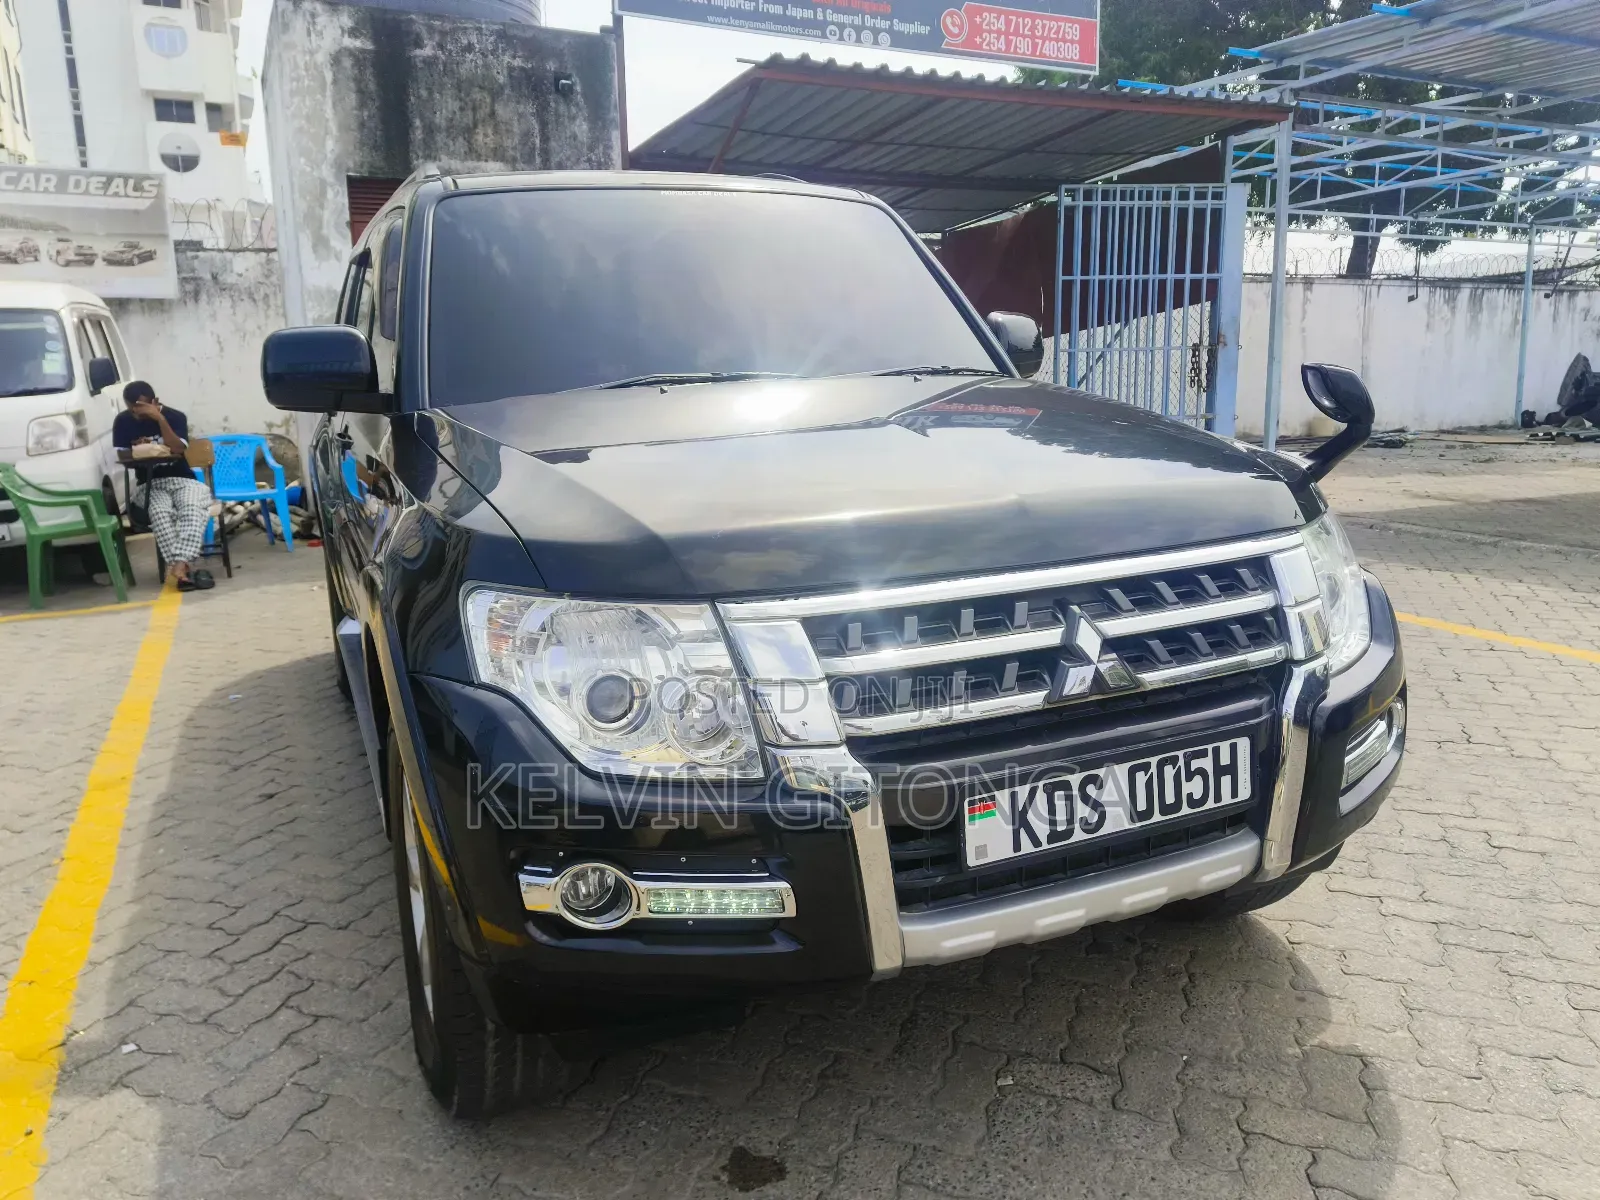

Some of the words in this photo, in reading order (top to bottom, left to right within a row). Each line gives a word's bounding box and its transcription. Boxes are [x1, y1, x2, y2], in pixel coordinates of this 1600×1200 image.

[706, 14, 822, 38] www.kenyamalikmotors.com
[758, 1, 784, 15] From
[785, 4, 814, 20] Japan
[816, 7, 825, 21] &
[826, 8, 862, 26] General
[864, 14, 892, 30] Order
[893, 18, 931, 36] Supplier
[974, 11, 1006, 32] +254
[1009, 15, 1032, 36] 712
[1034, 18, 1080, 41] 372759
[974, 32, 1006, 53] +254
[1009, 35, 1032, 56] 790
[1034, 38, 1080, 61] 740308
[0, 170, 58, 192] CAR
[66, 175, 160, 198] DEALS
[1010, 772, 1108, 854] KDS
[1127, 741, 1239, 823] 005H
